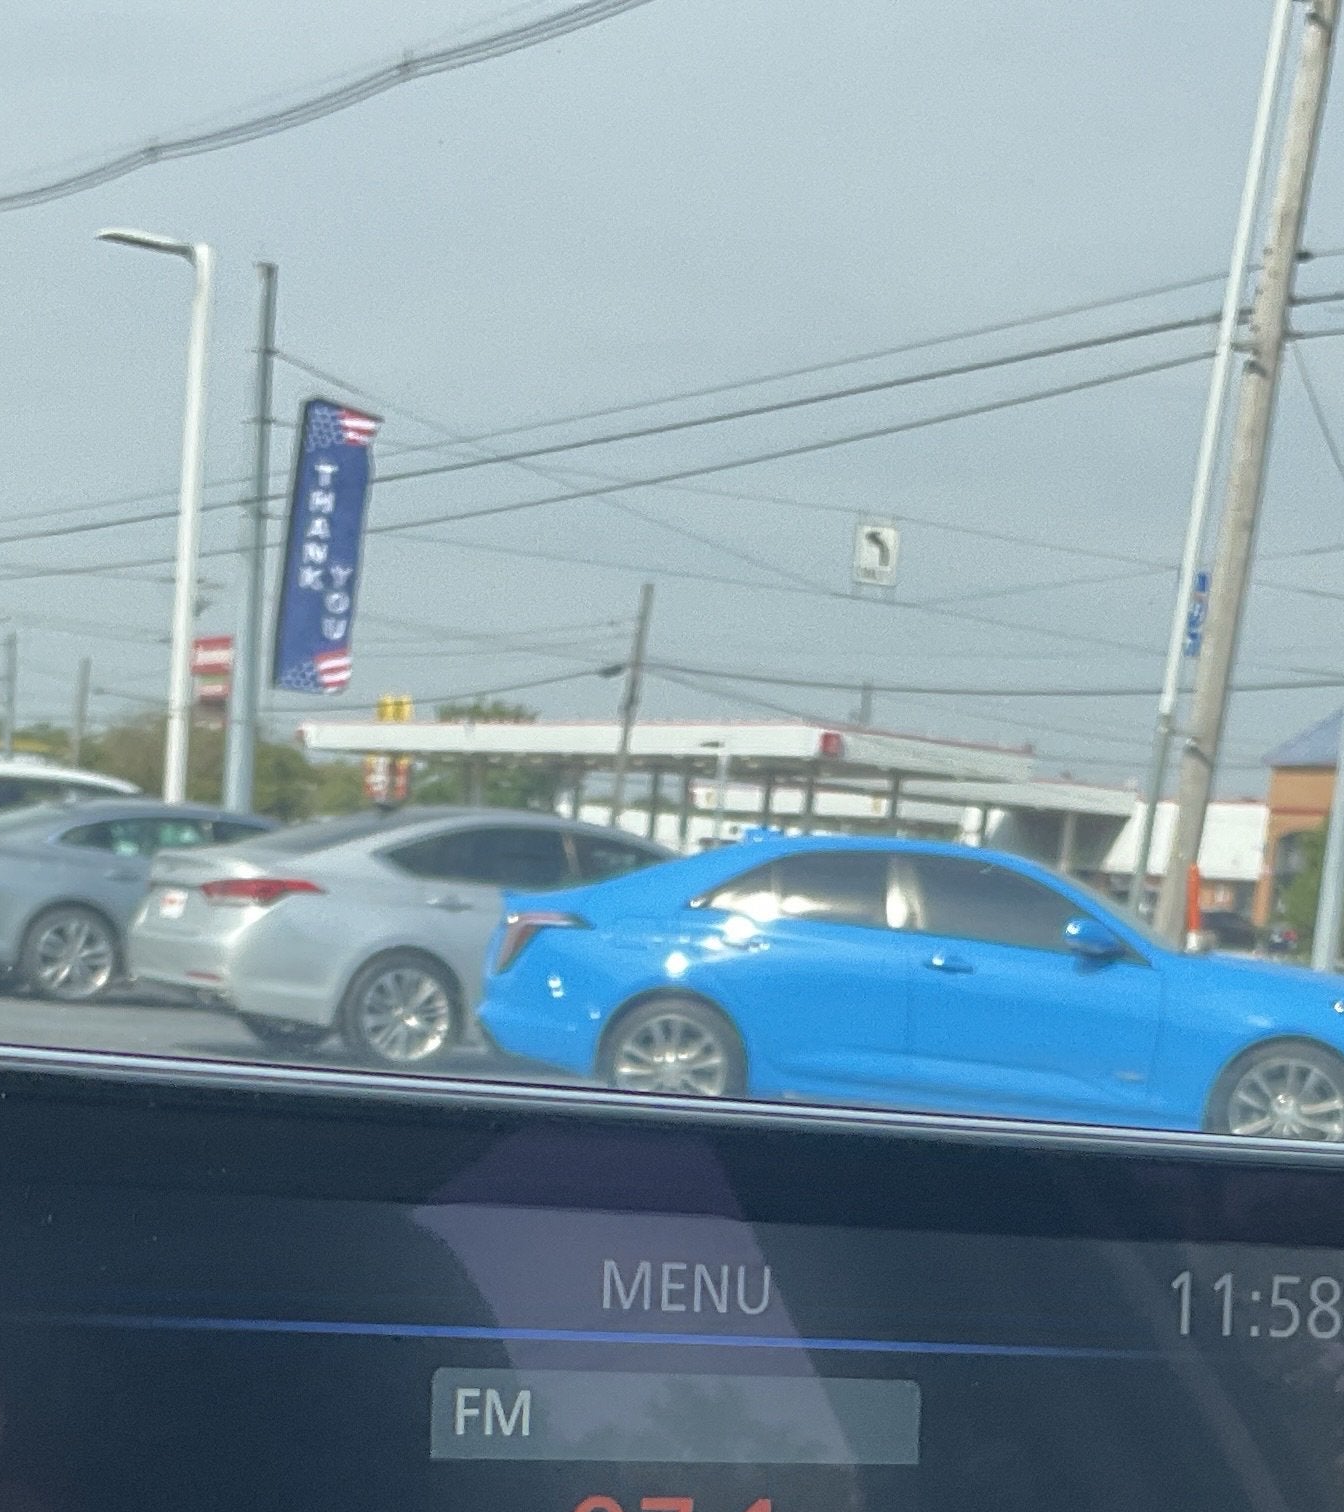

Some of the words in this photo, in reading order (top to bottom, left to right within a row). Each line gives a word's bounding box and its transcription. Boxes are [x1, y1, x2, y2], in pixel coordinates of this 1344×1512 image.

[298, 461, 338, 591] THANK
[320, 565, 353, 640] YOU
[601, 1259, 772, 1316] MENU
[1168, 1270, 1343, 1340] 11:58
[454, 1387, 532, 1437] FM
